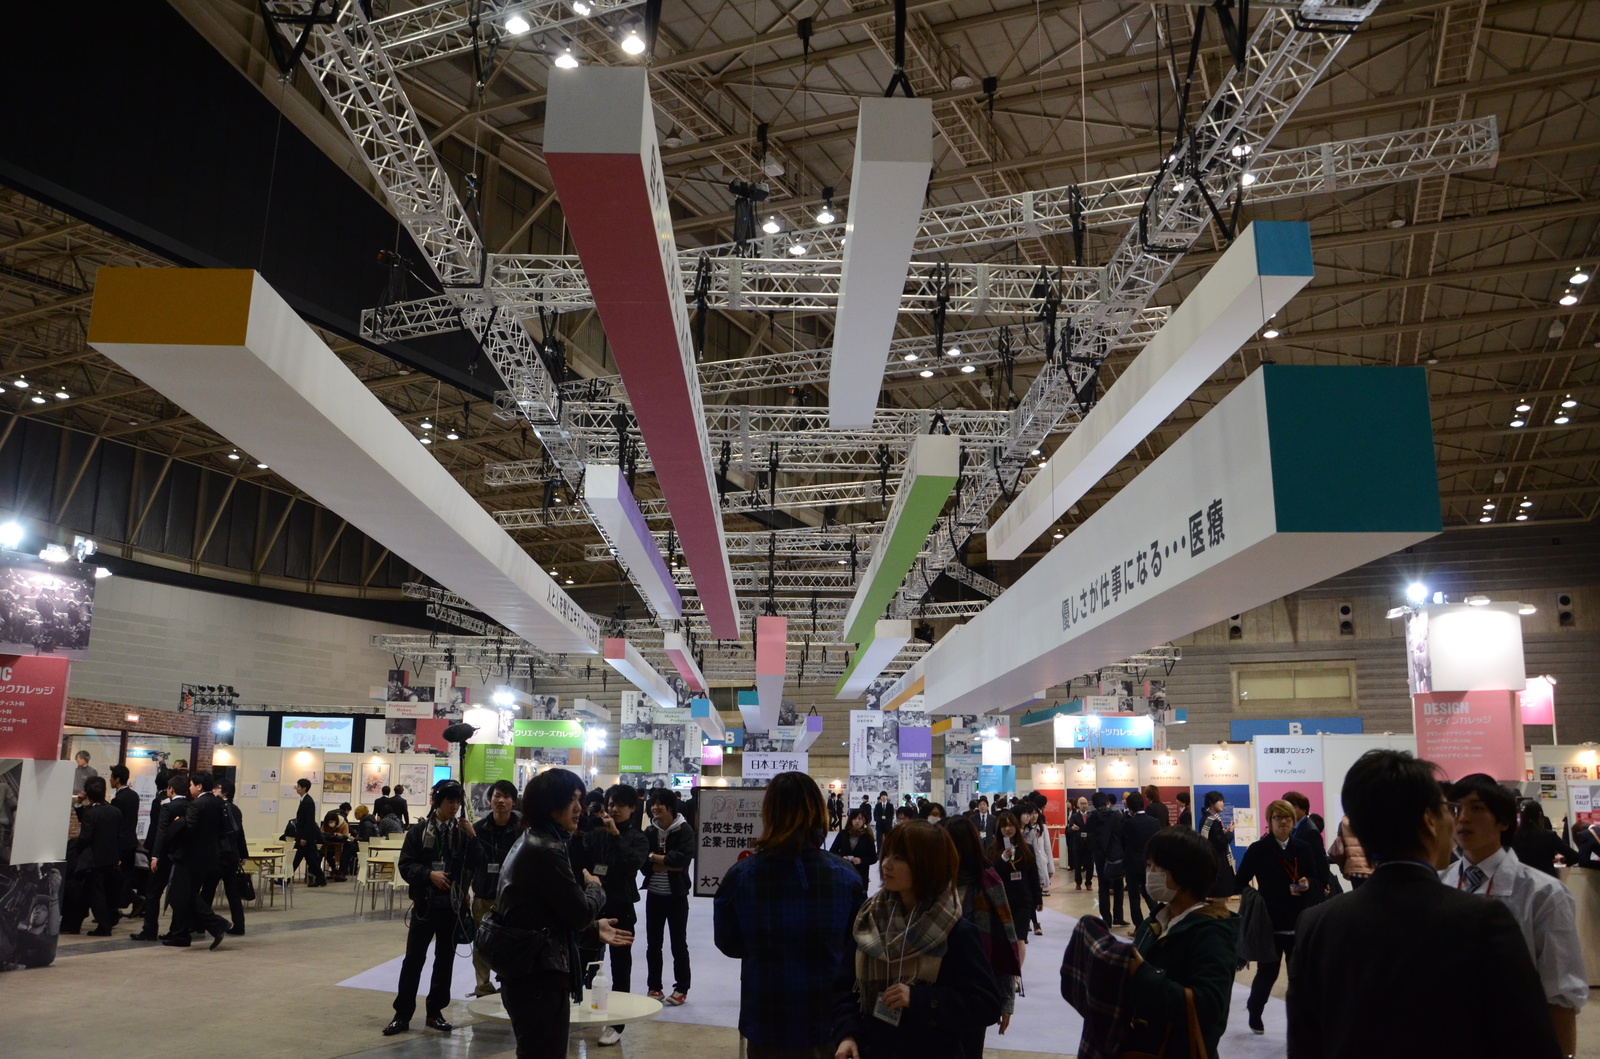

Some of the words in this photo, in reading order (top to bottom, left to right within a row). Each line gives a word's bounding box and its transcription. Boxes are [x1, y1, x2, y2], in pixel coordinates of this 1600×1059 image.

[1424, 702, 1470, 715] DESIGN
[1425, 716, 1492, 725] デザインカレッジ
[515, 730, 581, 738] クリエイターズカレッジ
[1289, 722, 1303, 735] B
[725, 732, 735, 744] B
[752, 760, 799, 770] 日本工学院
[702, 822, 753, 834] 高校生受付
